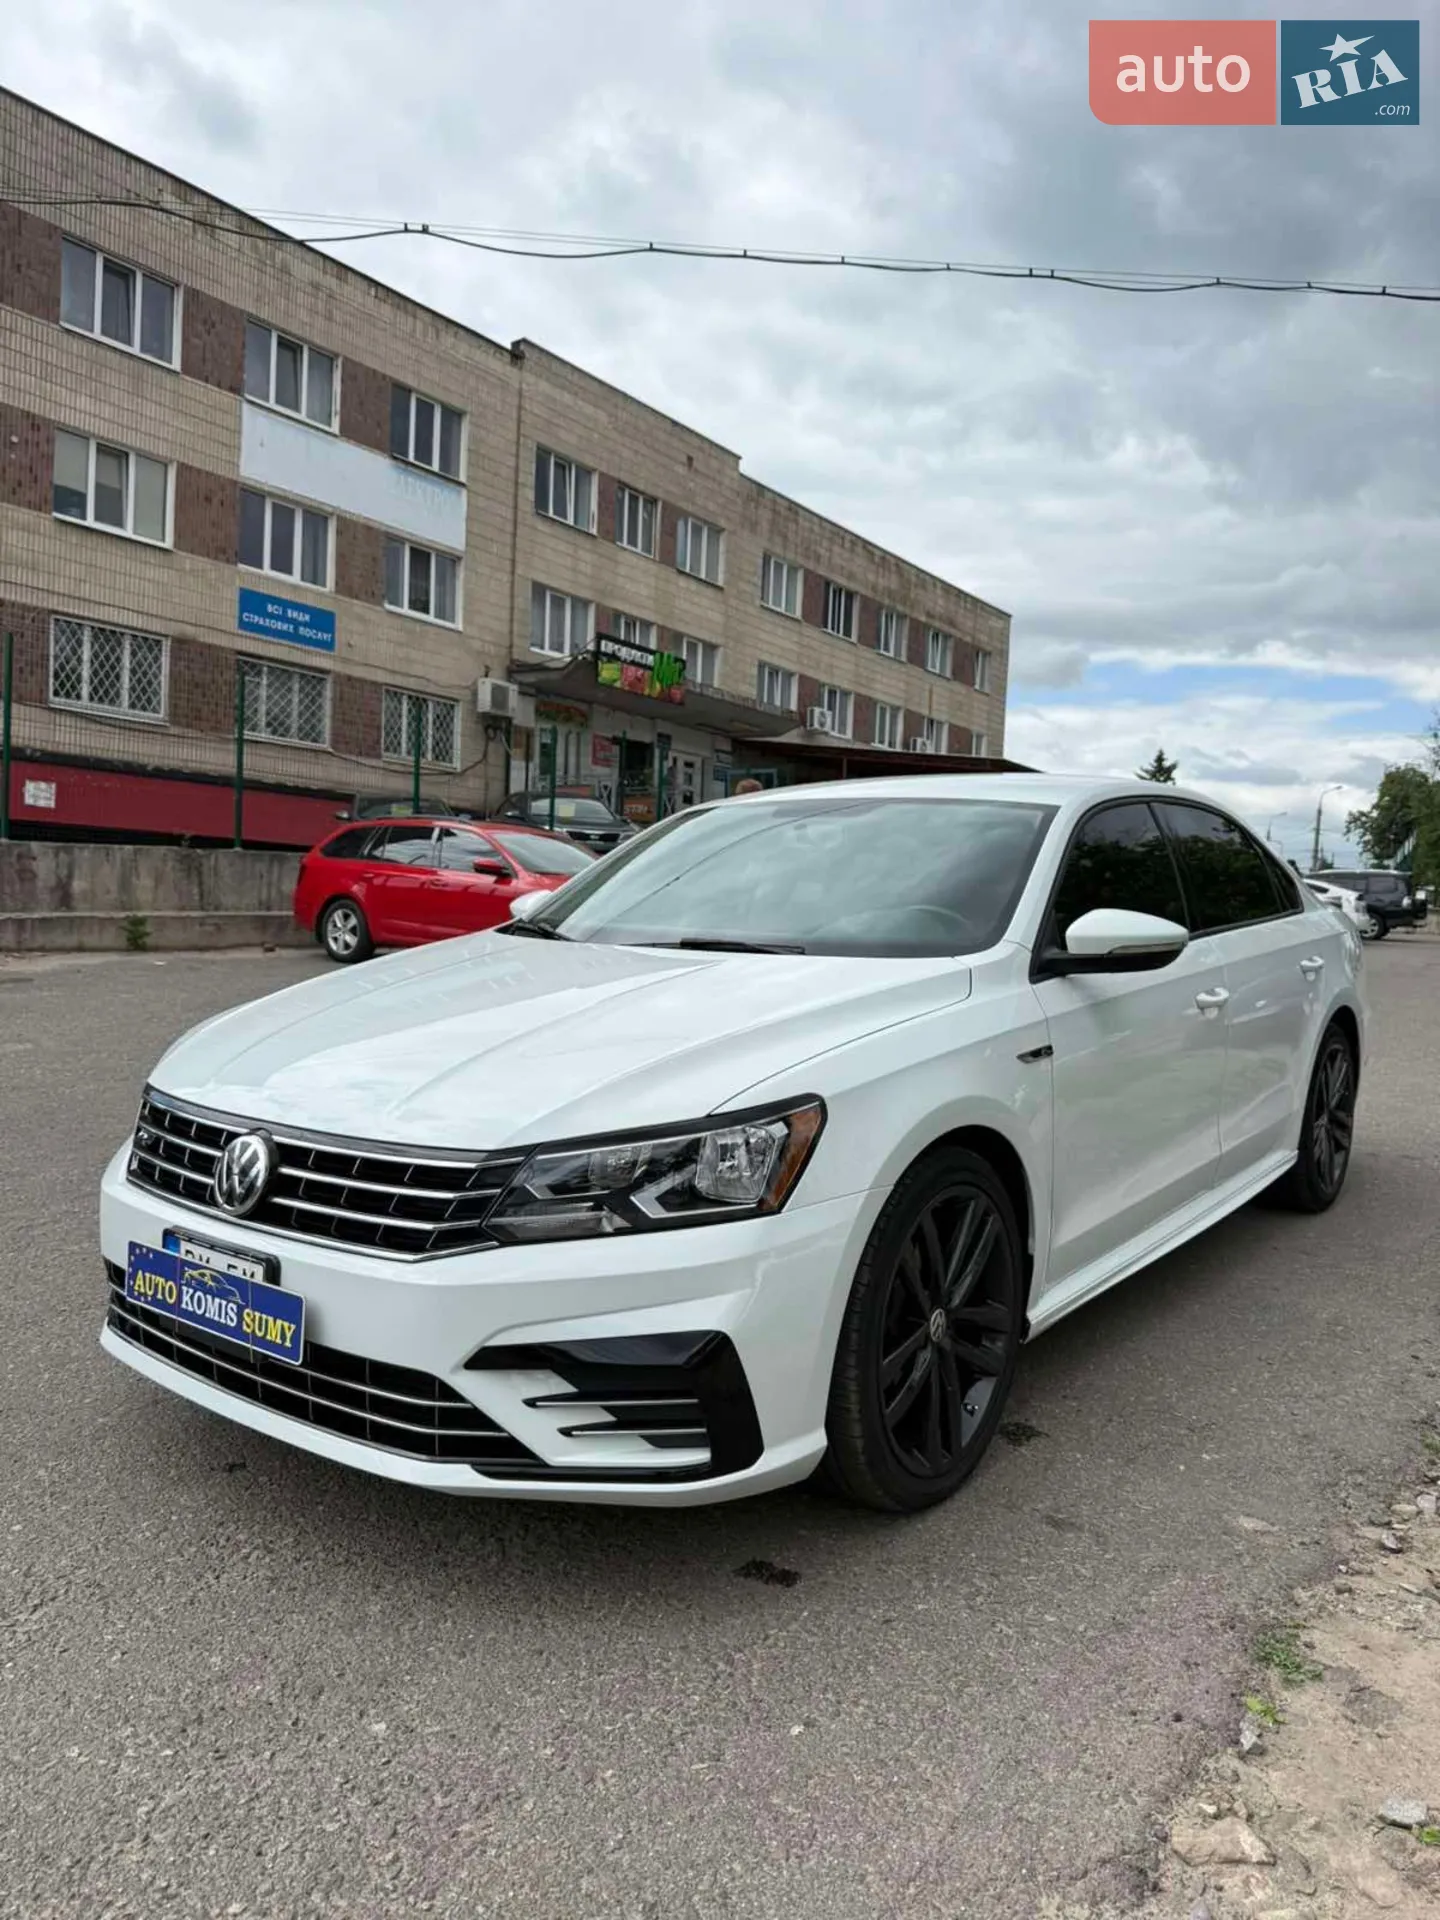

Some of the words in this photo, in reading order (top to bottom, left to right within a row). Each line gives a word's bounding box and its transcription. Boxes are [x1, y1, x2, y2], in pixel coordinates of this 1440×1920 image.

[266, 602, 283, 616] ВСІ
[134, 1270, 177, 1304] AUTO
[181, 1285, 238, 1327] KOMIS
[242, 1308, 296, 1347] SUMY
